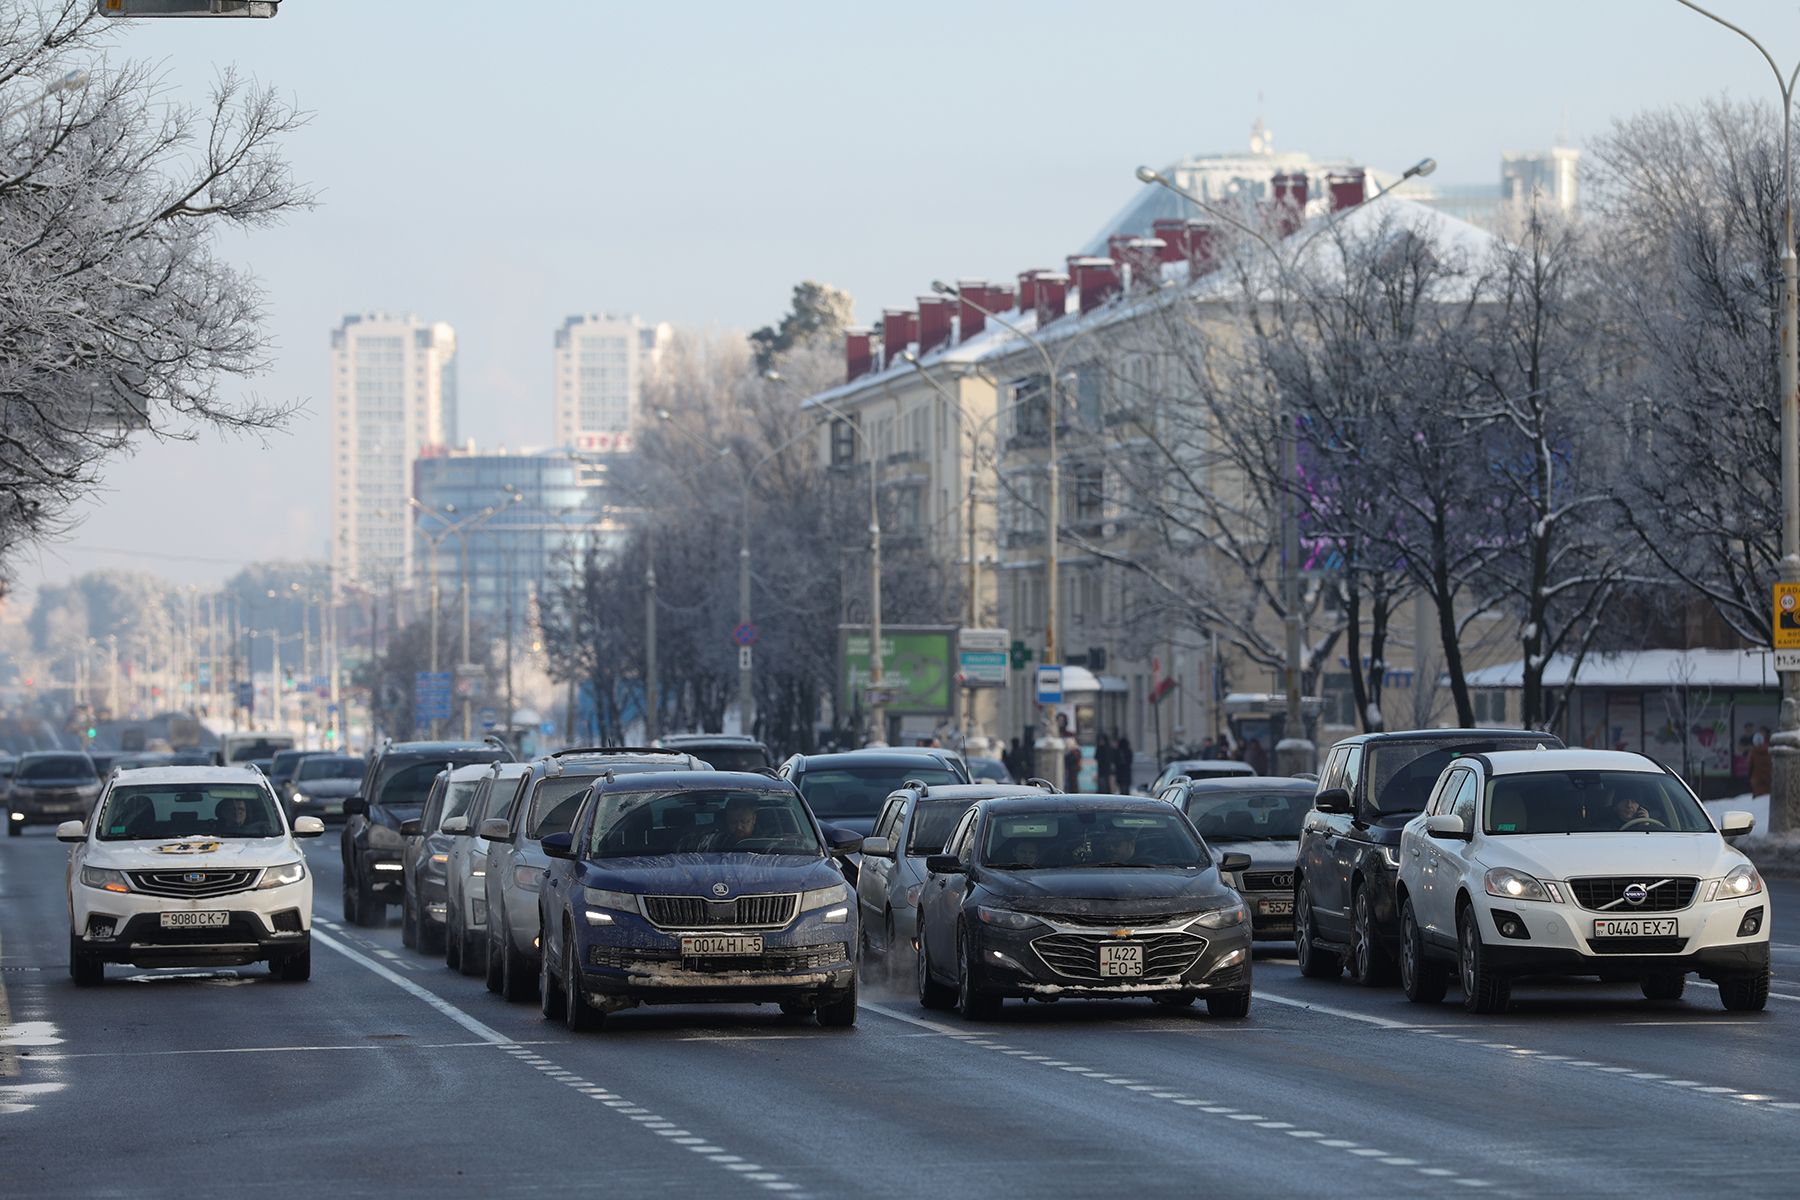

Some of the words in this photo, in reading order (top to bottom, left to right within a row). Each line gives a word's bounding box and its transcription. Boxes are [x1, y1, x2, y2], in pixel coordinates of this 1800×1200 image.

[1269, 902, 1294, 913] 5575
[171, 913, 197, 925] 9080
[199, 913, 228, 924] CK-7
[1607, 921, 1638, 936] 0440
[1643, 921, 1675, 935] EX-7
[694, 939, 724, 952] 0014
[1107, 947, 1137, 961] 1422
[1108, 961, 1142, 976] EO-5
